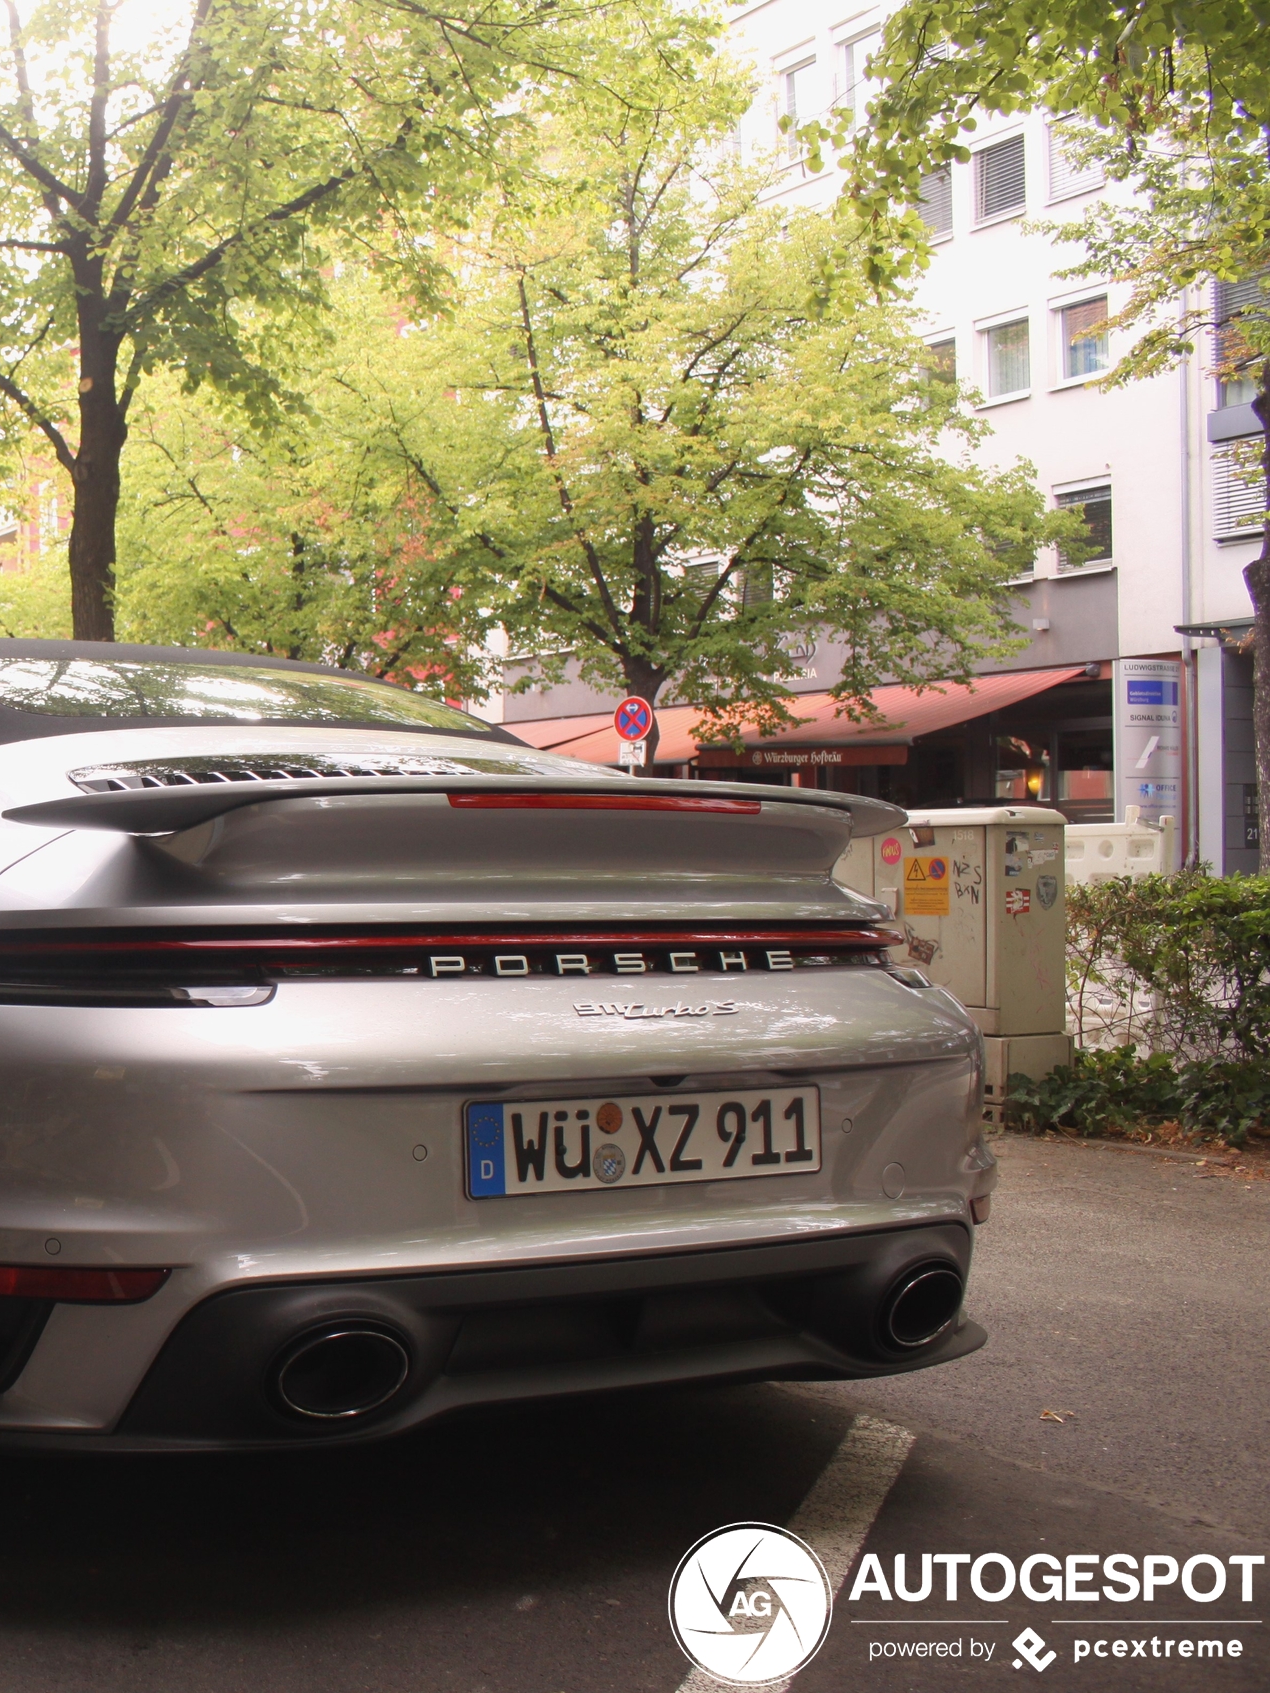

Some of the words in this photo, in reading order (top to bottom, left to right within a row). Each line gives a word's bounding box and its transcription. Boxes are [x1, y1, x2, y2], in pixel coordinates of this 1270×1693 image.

[1130, 714, 1154, 722] SIGNAL
[764, 751, 809, 767] Würzburger
[810, 750, 842, 765] Hofbräu
[1156, 784, 1177, 792] OFFICE
[953, 829, 975, 841] 1518
[1246, 828, 1258, 840] 21
[430, 950, 794, 978] PORSCHE
[480, 1160, 494, 1180] D
[716, 1096, 813, 1168] 911
